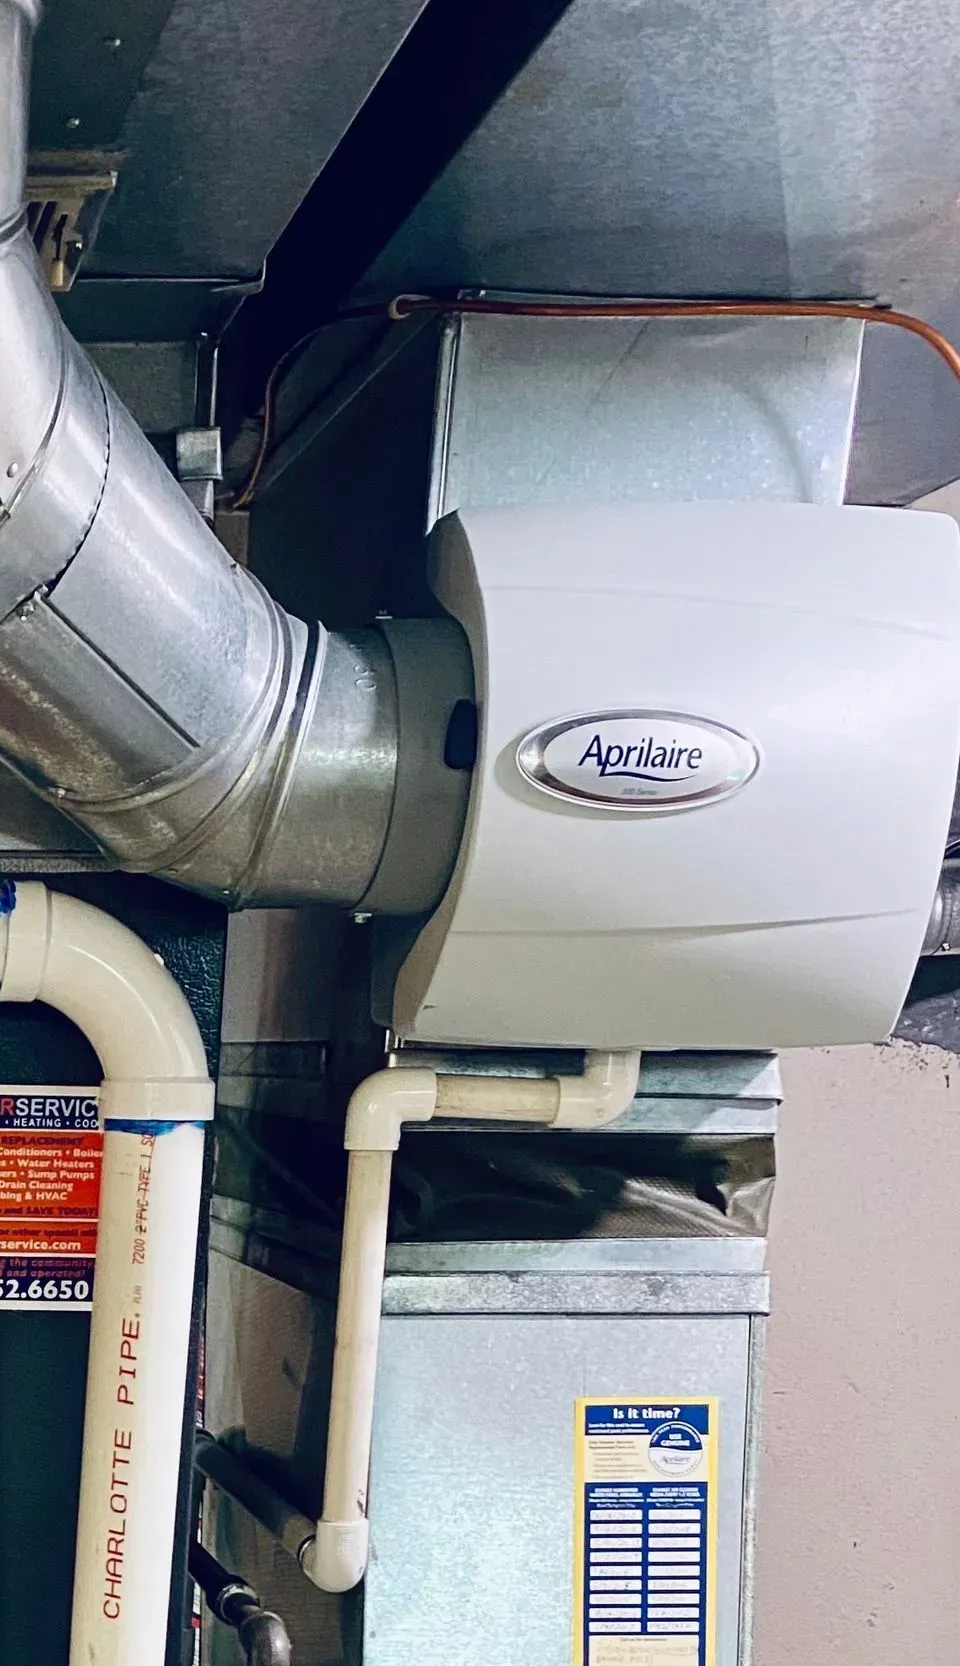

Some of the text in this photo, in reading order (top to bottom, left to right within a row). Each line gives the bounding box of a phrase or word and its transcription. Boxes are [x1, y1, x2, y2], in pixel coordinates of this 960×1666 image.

[578, 734, 702, 777] Aprilaire
[14, 1118, 61, 1128] HEATING
[75, 1119, 98, 1128] COO
[73, 1148, 103, 1158] Boiler
[17, 1159, 49, 1168] Water
[53, 1160, 94, 1169] Heaters
[27, 1170, 57, 1181] Sump
[59, 1170, 95, 1181] Pumps
[29, 1181, 74, 1191] Cleaning
[25, 1191, 32, 1200] &
[36, 1192, 68, 1201] HVAC
[132, 1238, 145, 1265] 7200
[613, 1407, 681, 1419] Is it time?
[103, 1429, 132, 1620] CHARLOTTE
